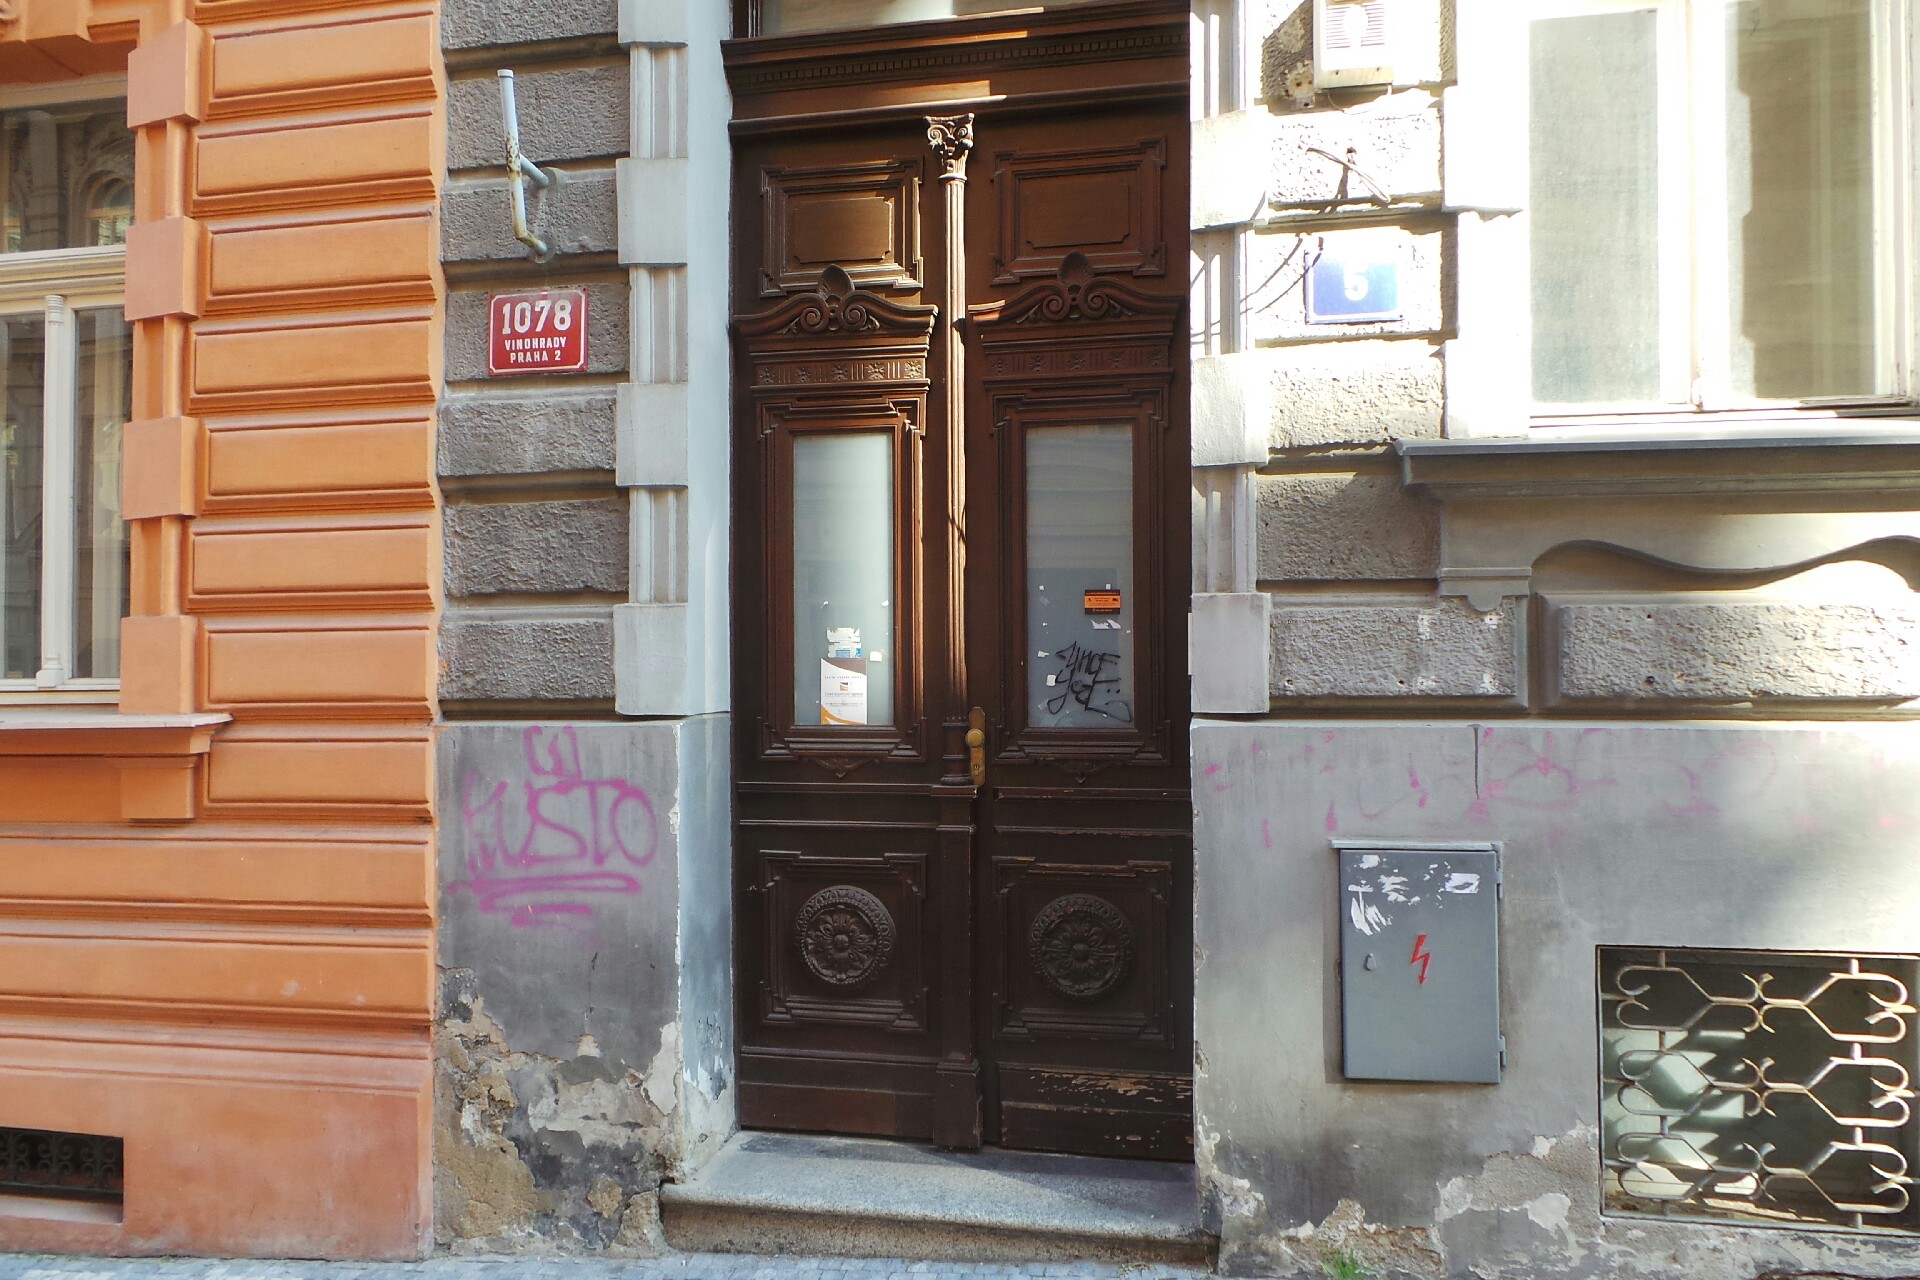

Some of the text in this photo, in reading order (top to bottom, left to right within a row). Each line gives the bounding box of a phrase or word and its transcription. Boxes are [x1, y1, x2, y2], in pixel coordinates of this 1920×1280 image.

[502, 299, 572, 335] 1078
[504, 336, 567, 351] VINOHRADY
[510, 350, 562, 364] PRAHA 2
